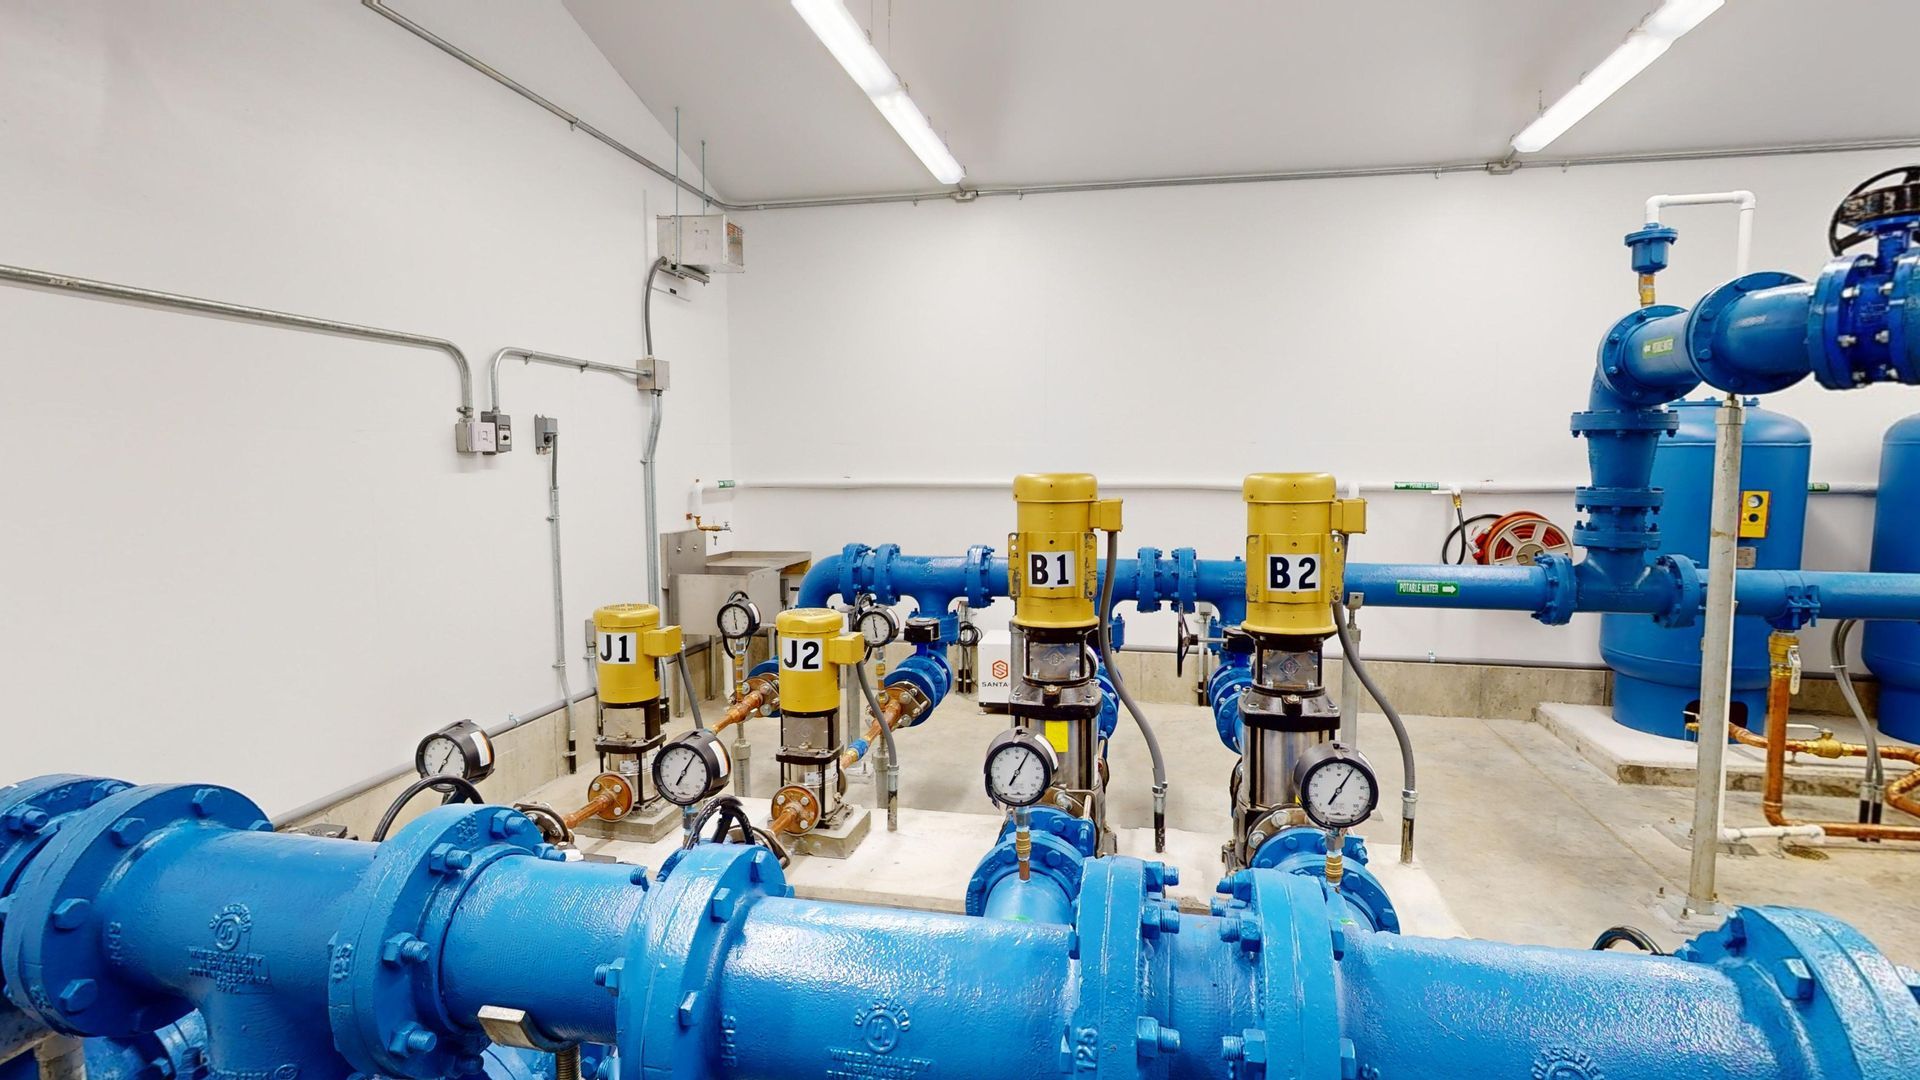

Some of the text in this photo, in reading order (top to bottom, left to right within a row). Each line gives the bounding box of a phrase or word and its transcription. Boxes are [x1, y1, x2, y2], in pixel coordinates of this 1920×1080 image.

[1399, 582, 1438, 593] POTABLE WATER
[600, 634, 630, 662] J1
[783, 640, 819, 669] J2
[1076, 1026, 1098, 1072] 125
